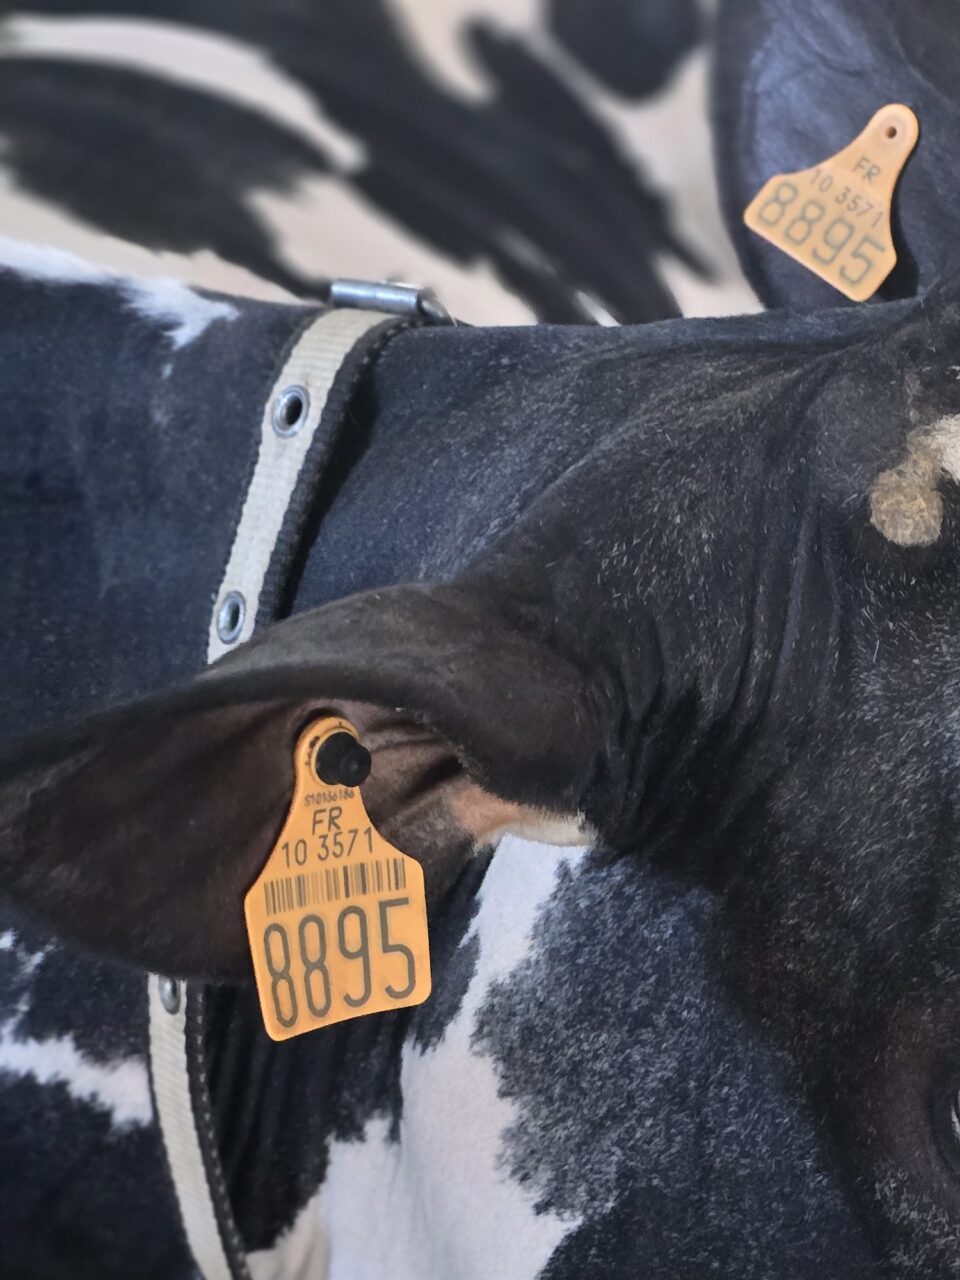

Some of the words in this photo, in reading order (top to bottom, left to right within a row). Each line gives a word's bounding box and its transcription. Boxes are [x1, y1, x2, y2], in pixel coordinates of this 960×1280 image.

[852, 156, 881, 184] FR
[809, 169, 834, 193] 10
[834, 187, 884, 229] 3571
[758, 181, 886, 285] 8895
[312, 806, 343, 836] FR
[281, 838, 308, 869] 10
[317, 827, 374, 861] 3571
[263, 897, 417, 1028] 8895
